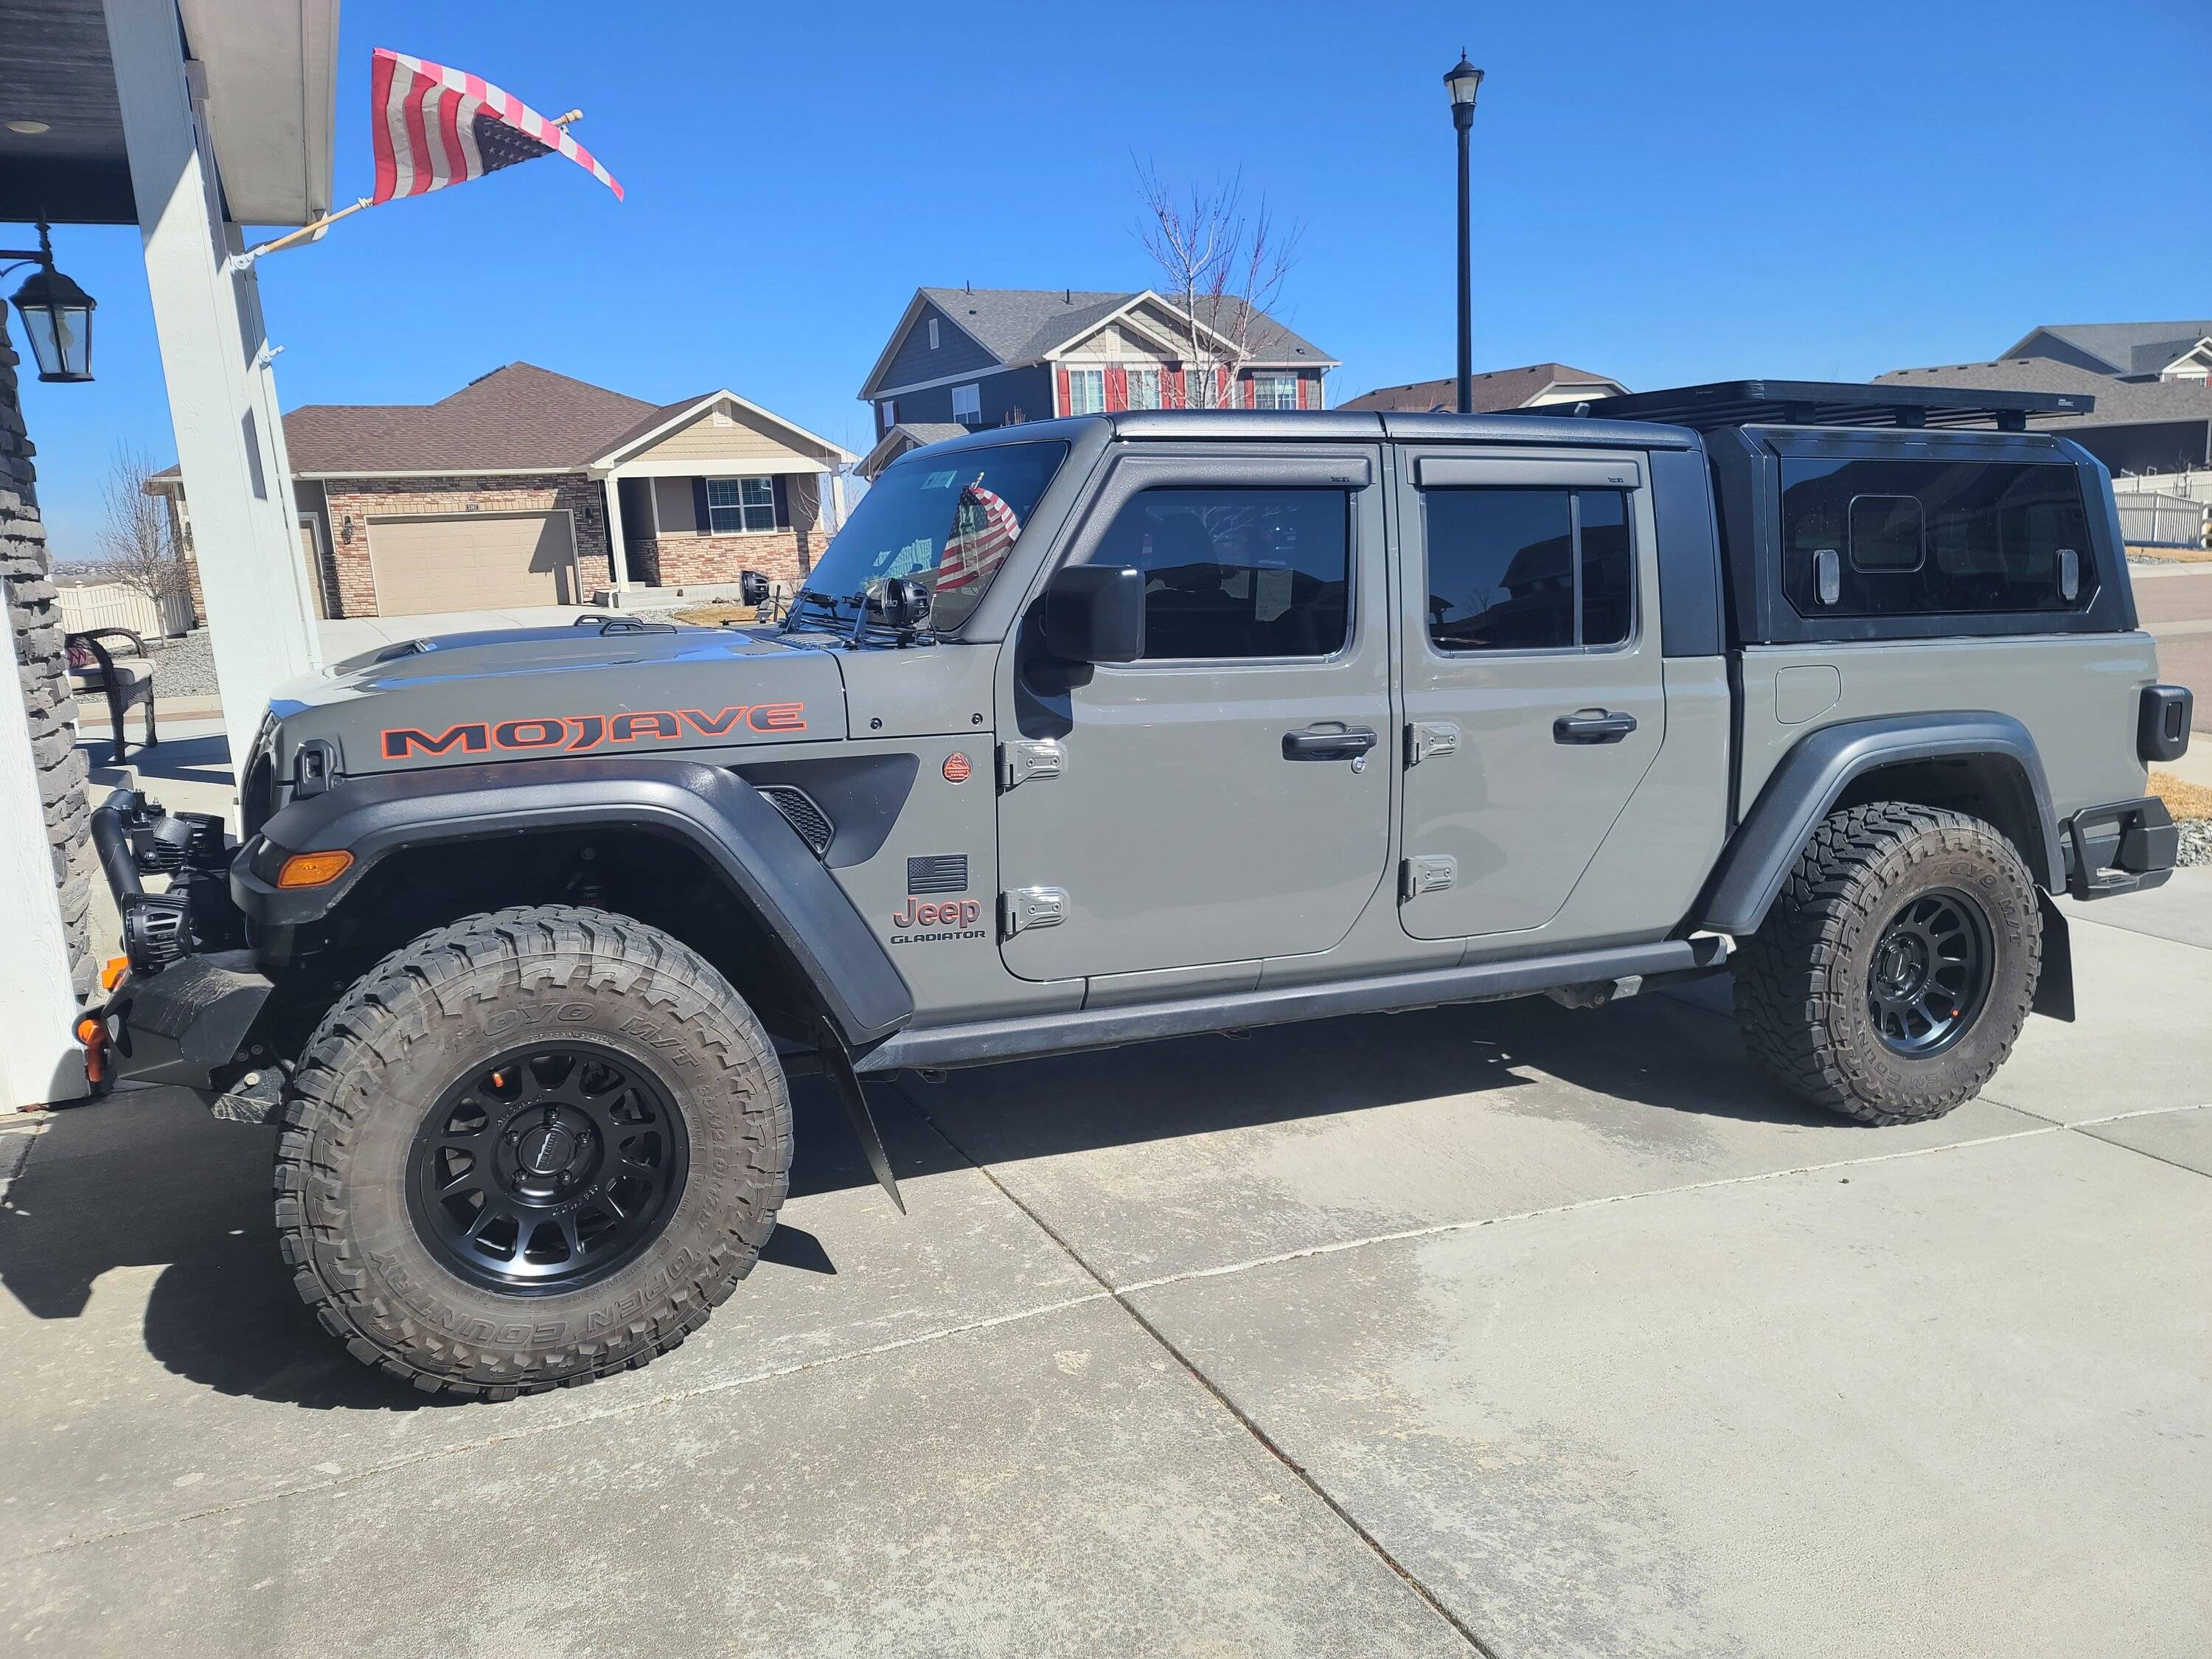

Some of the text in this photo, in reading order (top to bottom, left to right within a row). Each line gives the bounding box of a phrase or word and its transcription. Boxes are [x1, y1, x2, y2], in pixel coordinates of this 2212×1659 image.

[381, 702, 807, 759] MOJAVE
[890, 930, 987, 945] GLADIATOR
[893, 897, 981, 929] Jeep
[1998, 898, 2022, 947] M/T
[619, 1016, 700, 1068] M/T
[369, 1247, 695, 1343] OPEN COUNTRY
